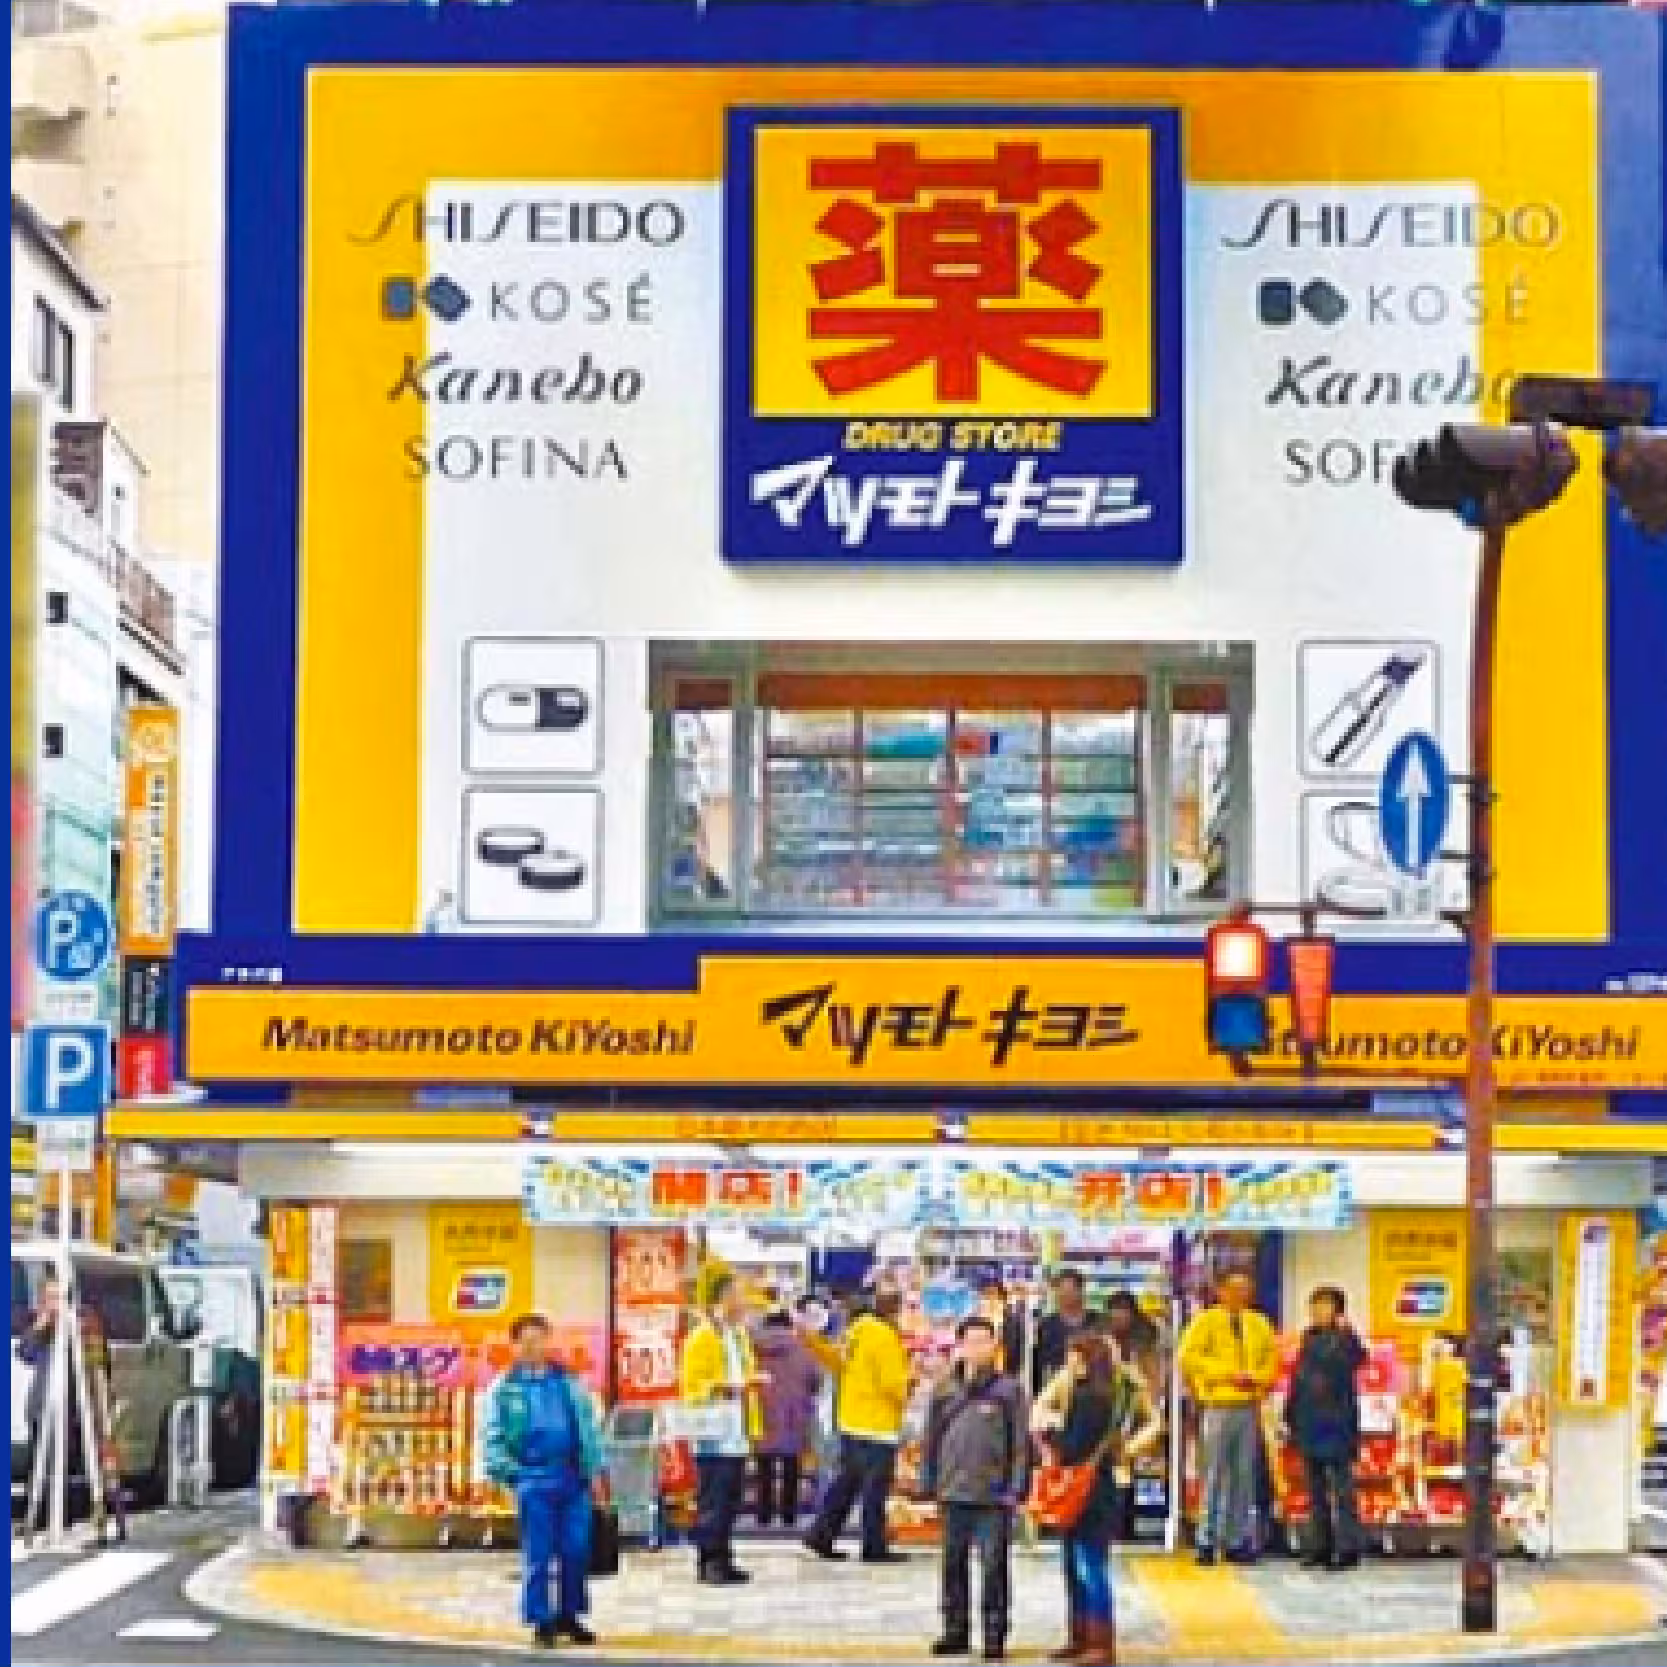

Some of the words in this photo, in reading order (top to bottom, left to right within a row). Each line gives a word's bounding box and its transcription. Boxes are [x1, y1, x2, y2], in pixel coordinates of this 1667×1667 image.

[348, 196, 687, 248] SHISEIDO
[1221, 199, 1561, 250] SHISEIDO
[806, 140, 1108, 404] 薬
[490, 273, 654, 324] KOSÉ
[1367, 273, 1527, 325] KOSÉ
[389, 351, 646, 405] Kanebo
[402, 434, 630, 482] SOFINA
[841, 421, 944, 451] DRUG
[948, 421, 1063, 451] STORE
[1284, 438, 1394, 487] SOF
[749, 455, 1152, 548] マツモトキヨシ
[260, 1017, 521, 1057] Matsumoto
[528, 1018, 697, 1057] KiYoshi
[762, 982, 1140, 1067] マツモトキヨシ
[45, 1034, 95, 1108] P
